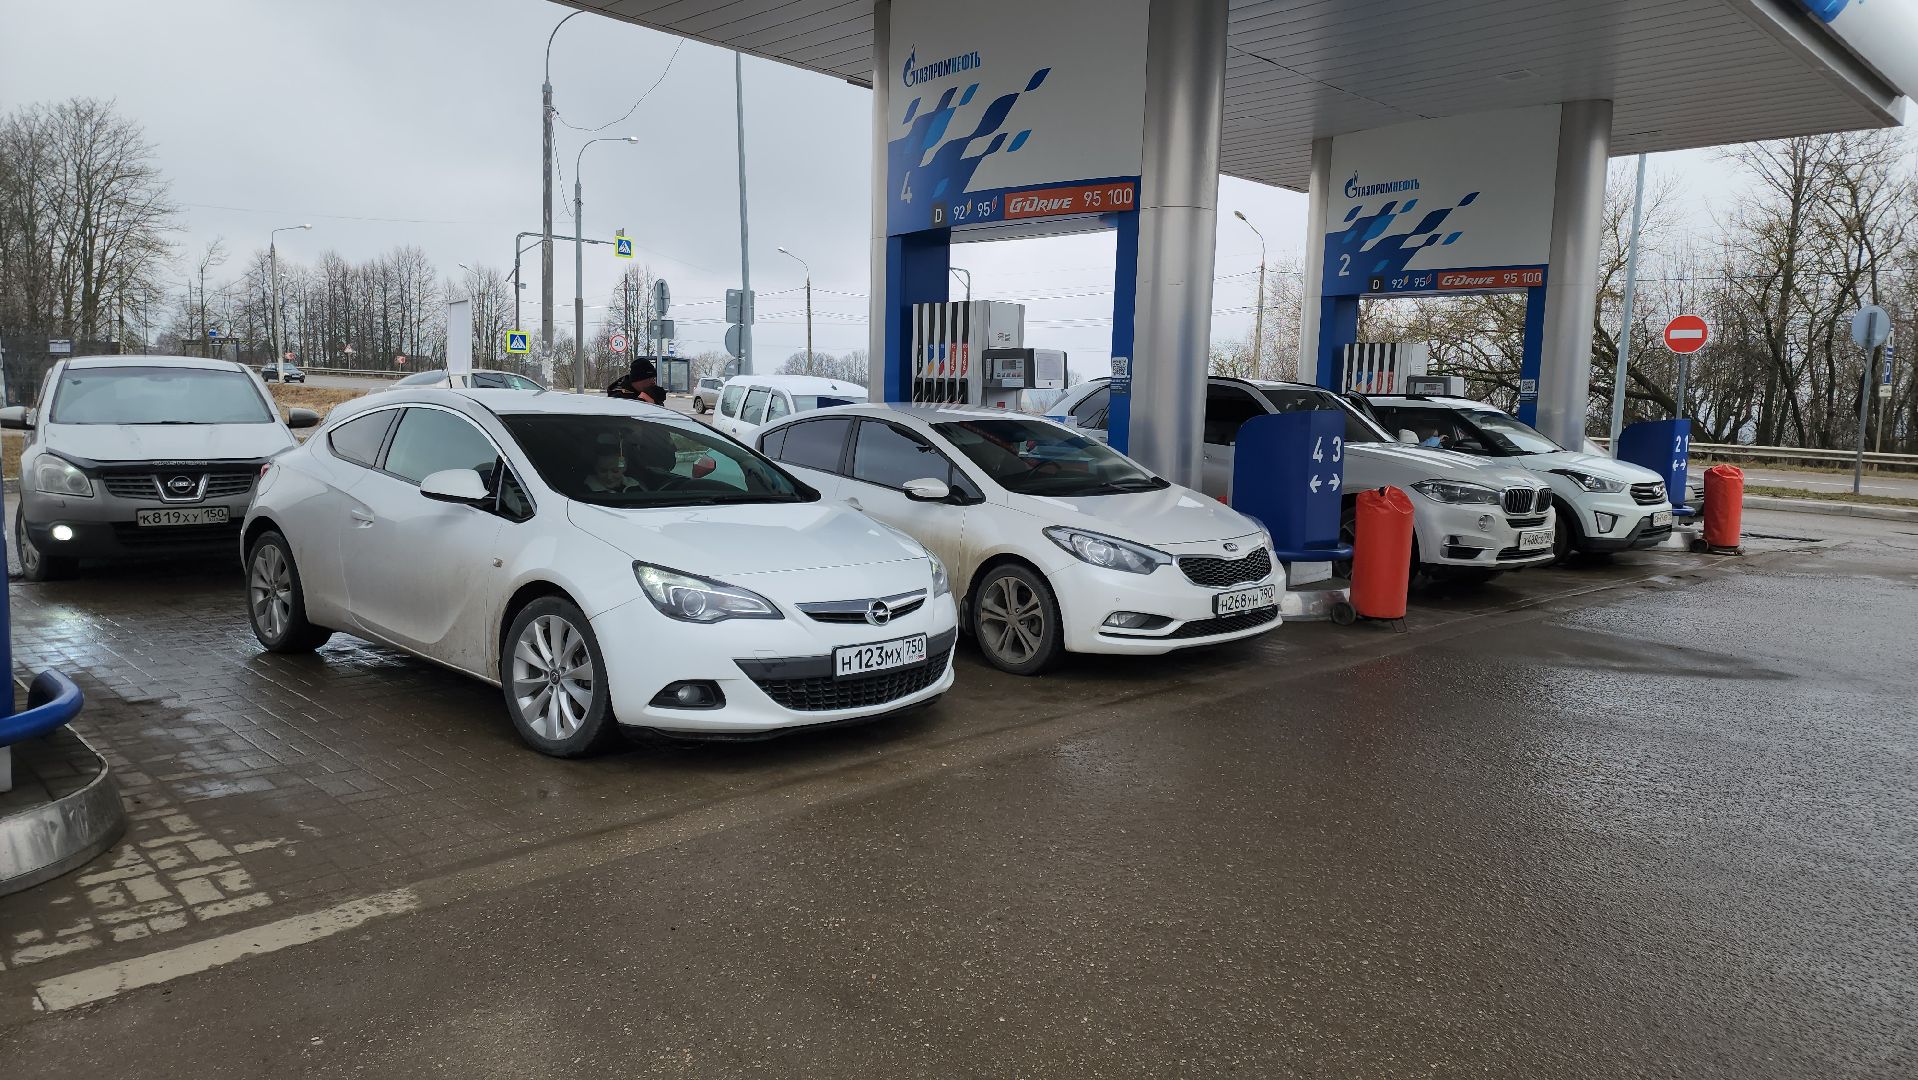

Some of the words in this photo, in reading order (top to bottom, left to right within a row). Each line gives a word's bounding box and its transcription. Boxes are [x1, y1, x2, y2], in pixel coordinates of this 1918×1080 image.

[914, 51, 981, 85] ГАЗПРОМНЕФТЬ
[900, 170, 913, 204] 4
[1357, 178, 1420, 198] ГАЗПРОМНЕФТЬ
[935, 208, 943, 223] D
[953, 205, 965, 221] 92
[977, 201, 990, 218] 95
[1083, 190, 1101, 207] 95
[1107, 187, 1133, 205] 100
[1339, 253, 1351, 276] 2
[1372, 279, 1380, 290] D
[1391, 278, 1403, 289] 92
[1414, 277, 1426, 288] 95
[1503, 273, 1518, 284] 95
[1522, 272, 1543, 284] 100
[1312, 436, 1323, 463] 4
[1332, 436, 1342, 463] 3
[1675, 435, 1682, 453] 2
[203, 508, 224, 518] 150
[843, 645, 902, 672] Н123МХ
[905, 638, 923, 656] 750
